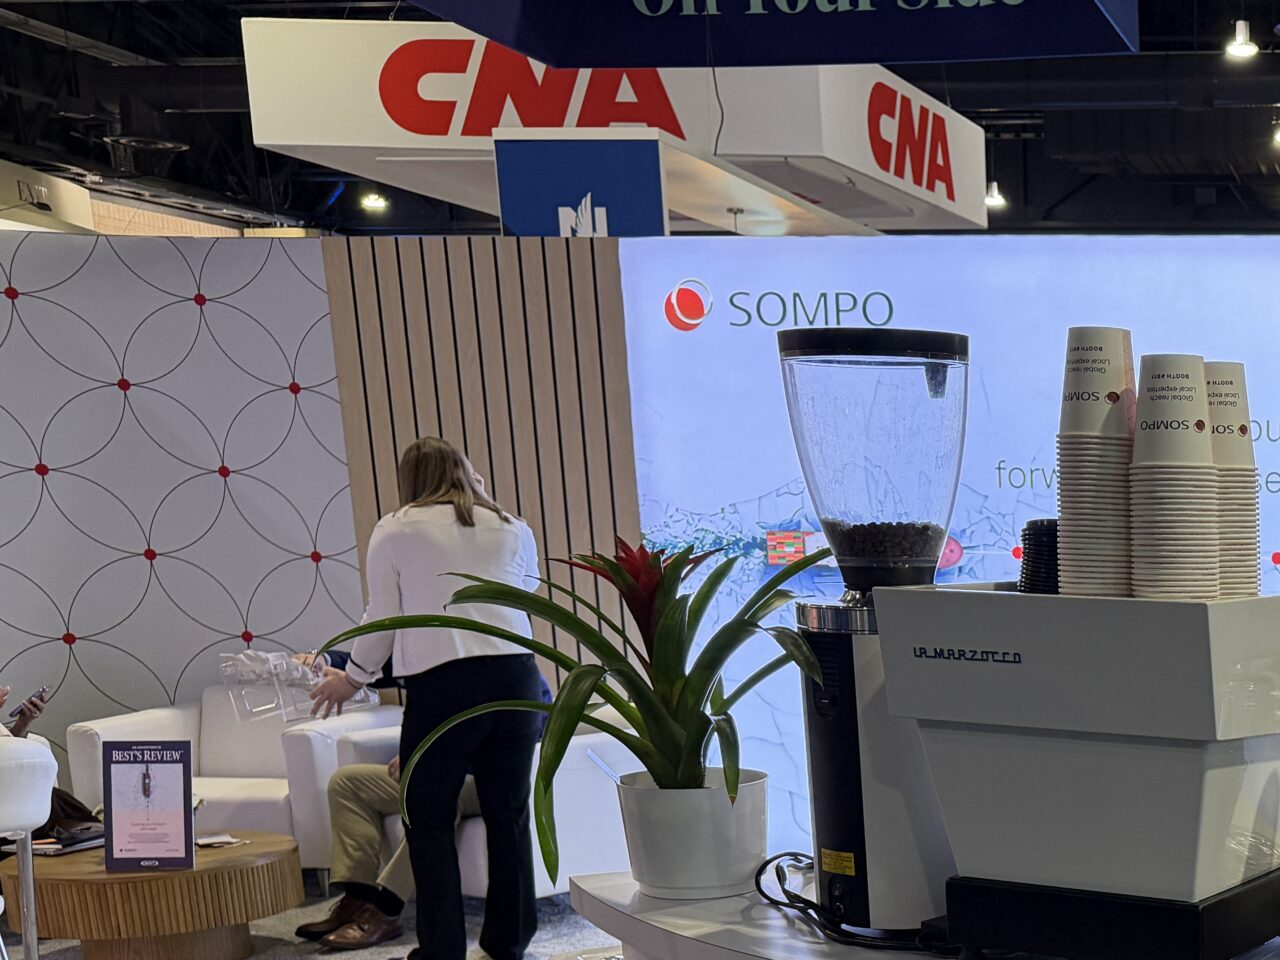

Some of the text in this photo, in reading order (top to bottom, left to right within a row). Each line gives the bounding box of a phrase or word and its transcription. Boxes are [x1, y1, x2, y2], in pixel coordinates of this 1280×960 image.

[378, 38, 687, 142] CNA
[867, 81, 956, 203] CNA
[728, 290, 894, 327] SOMPO
[1063, 391, 1100, 402] SOMP
[1179, 386, 1197, 395] Local
[1170, 394, 1194, 402] Global
[1140, 419, 1190, 431] SOMPO
[994, 459, 1060, 489] forw
[112, 750, 181, 761] BEST'S REVIEW
